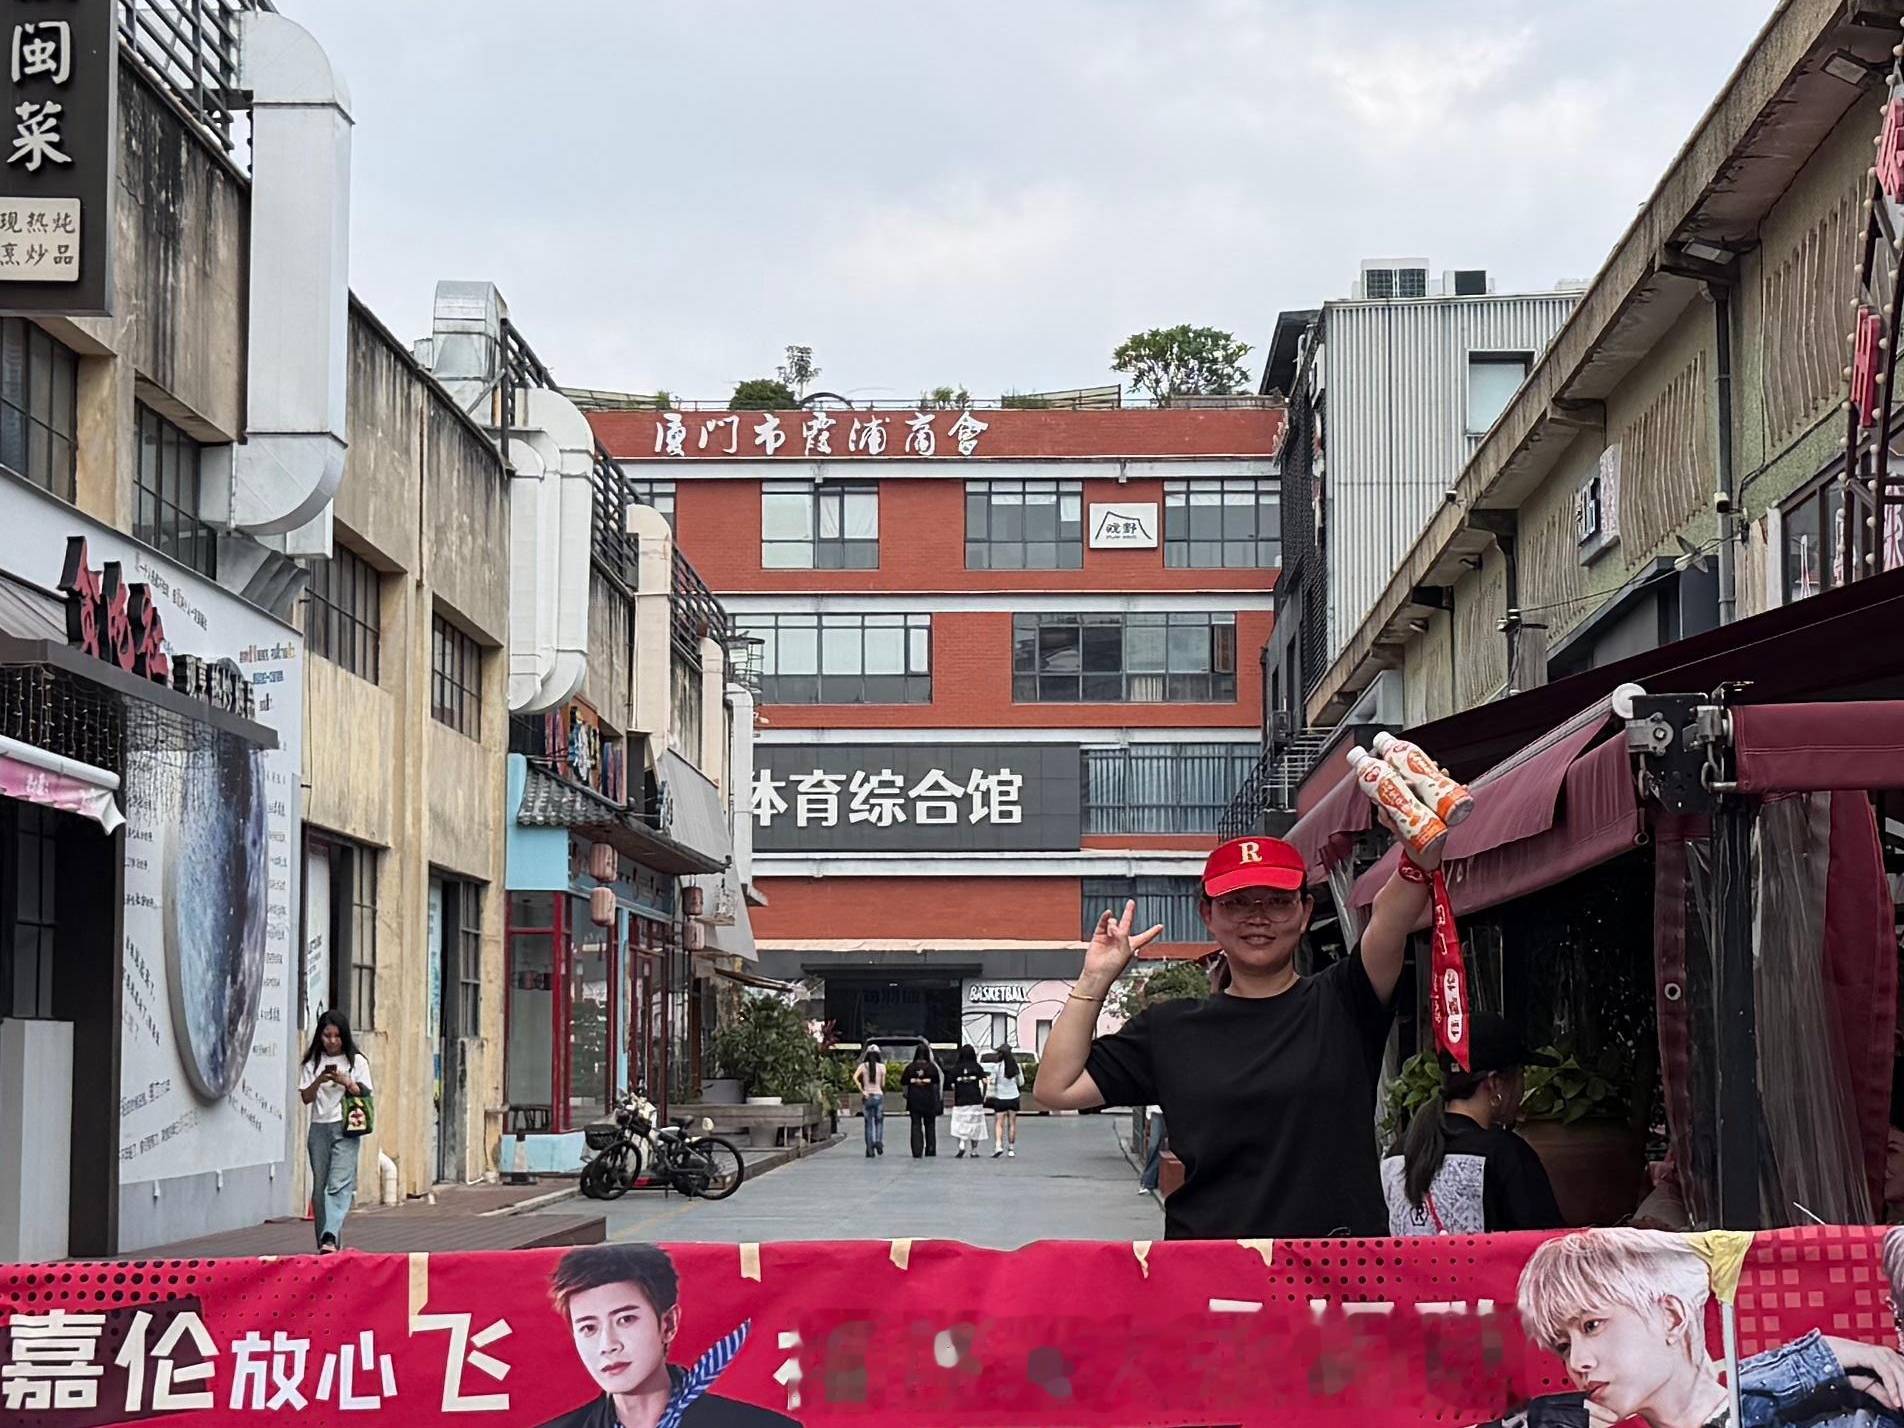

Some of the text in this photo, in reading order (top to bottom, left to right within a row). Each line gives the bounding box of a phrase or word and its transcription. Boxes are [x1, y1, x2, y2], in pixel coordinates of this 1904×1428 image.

[751, 768, 1024, 827] 体育综合馆
[1238, 841, 1263, 865] R
[968, 985, 1033, 1004] BASKETBALL
[1, 1307, 512, 1415] 嘉伦放心飞
